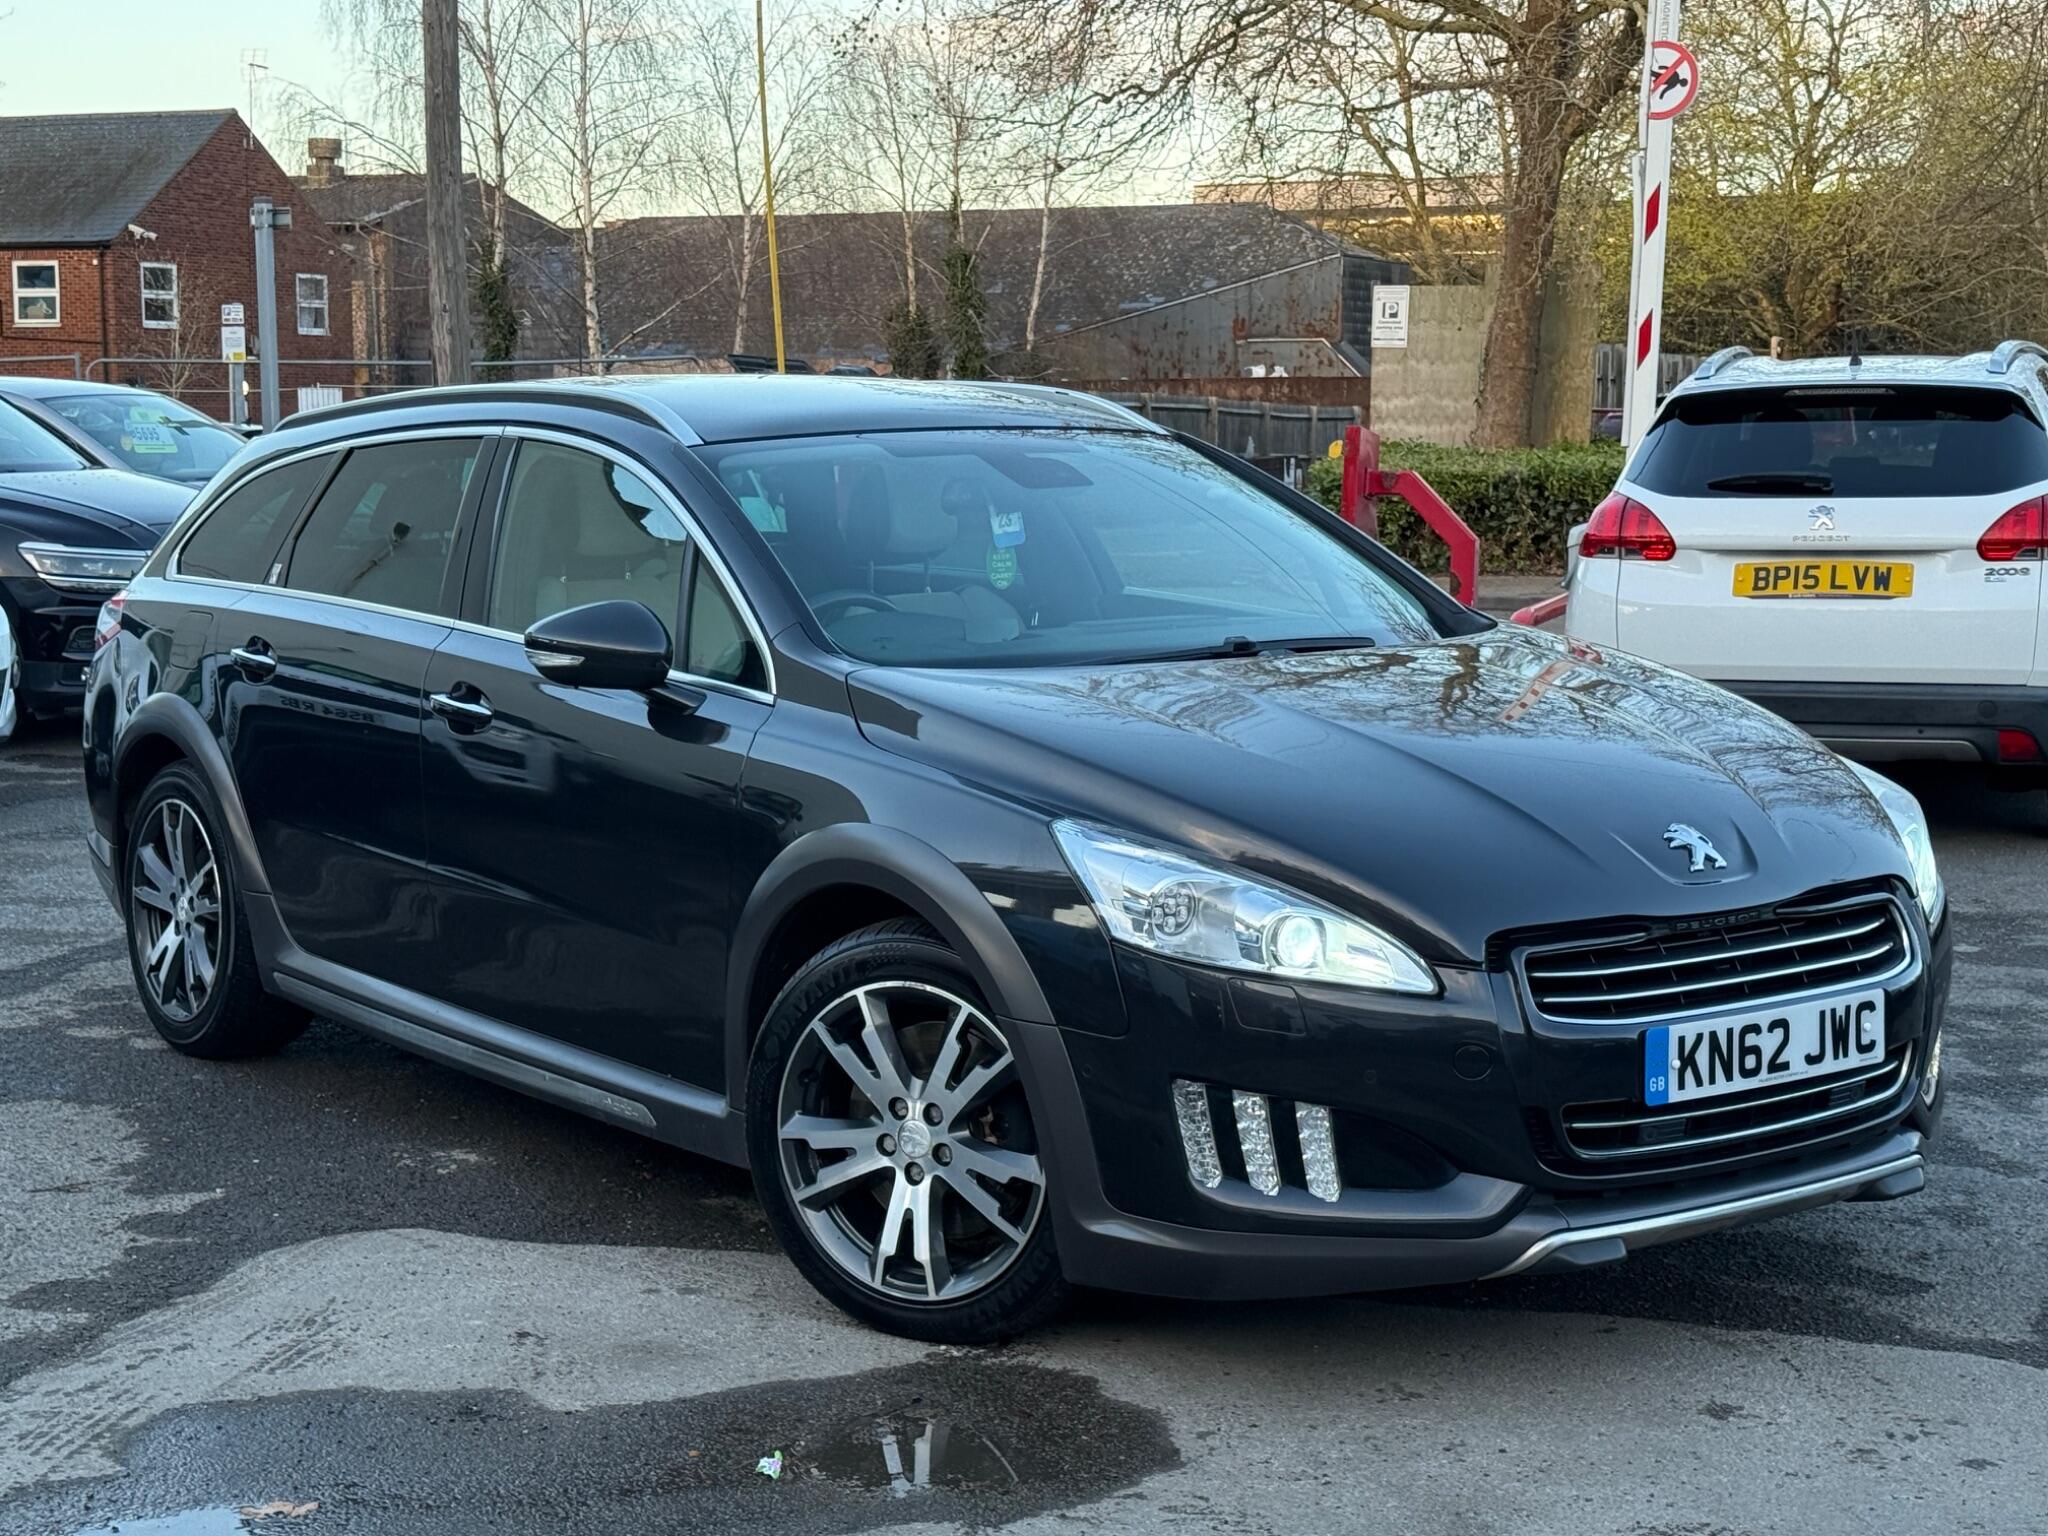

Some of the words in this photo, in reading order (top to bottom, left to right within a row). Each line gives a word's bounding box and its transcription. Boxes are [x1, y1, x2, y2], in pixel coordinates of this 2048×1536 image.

[1661, 0, 1671, 40] AGNETIC
[1792, 534, 1851, 543] PEUGEOT
[1752, 565, 1820, 592] BP15
[1829, 565, 1892, 592] LVW
[1676, 911, 1759, 930] PEUGEOT
[1677, 1017, 1790, 1091] KN62
[1803, 1000, 1877, 1067] JWC
[1649, 1076, 1665, 1092] GB
